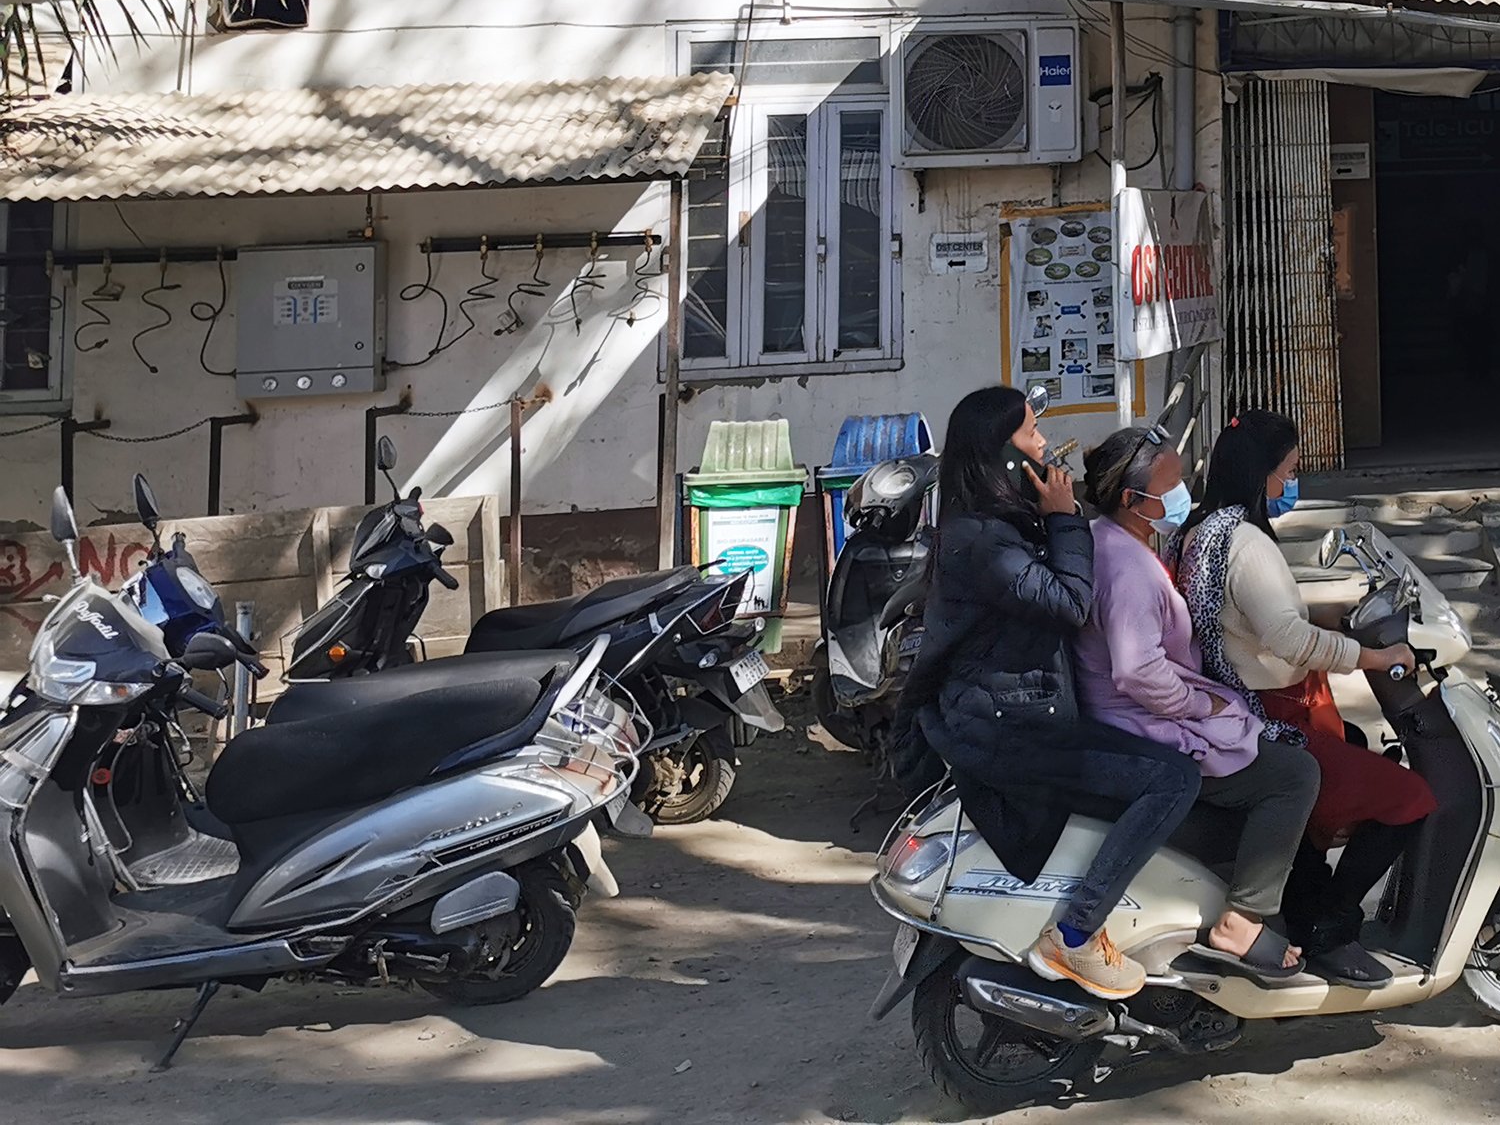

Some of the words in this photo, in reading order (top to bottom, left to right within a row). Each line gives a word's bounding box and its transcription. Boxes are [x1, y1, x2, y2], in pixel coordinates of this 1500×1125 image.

[1040, 64, 1071, 76] Haier
[1403, 119, 1494, 136] Tele-ICU
[952, 242, 983, 251] CENTER
[1131, 244, 1160, 306] OST
[469, 832, 511, 851] LIMITED
[511, 816, 554, 837] EDITION
